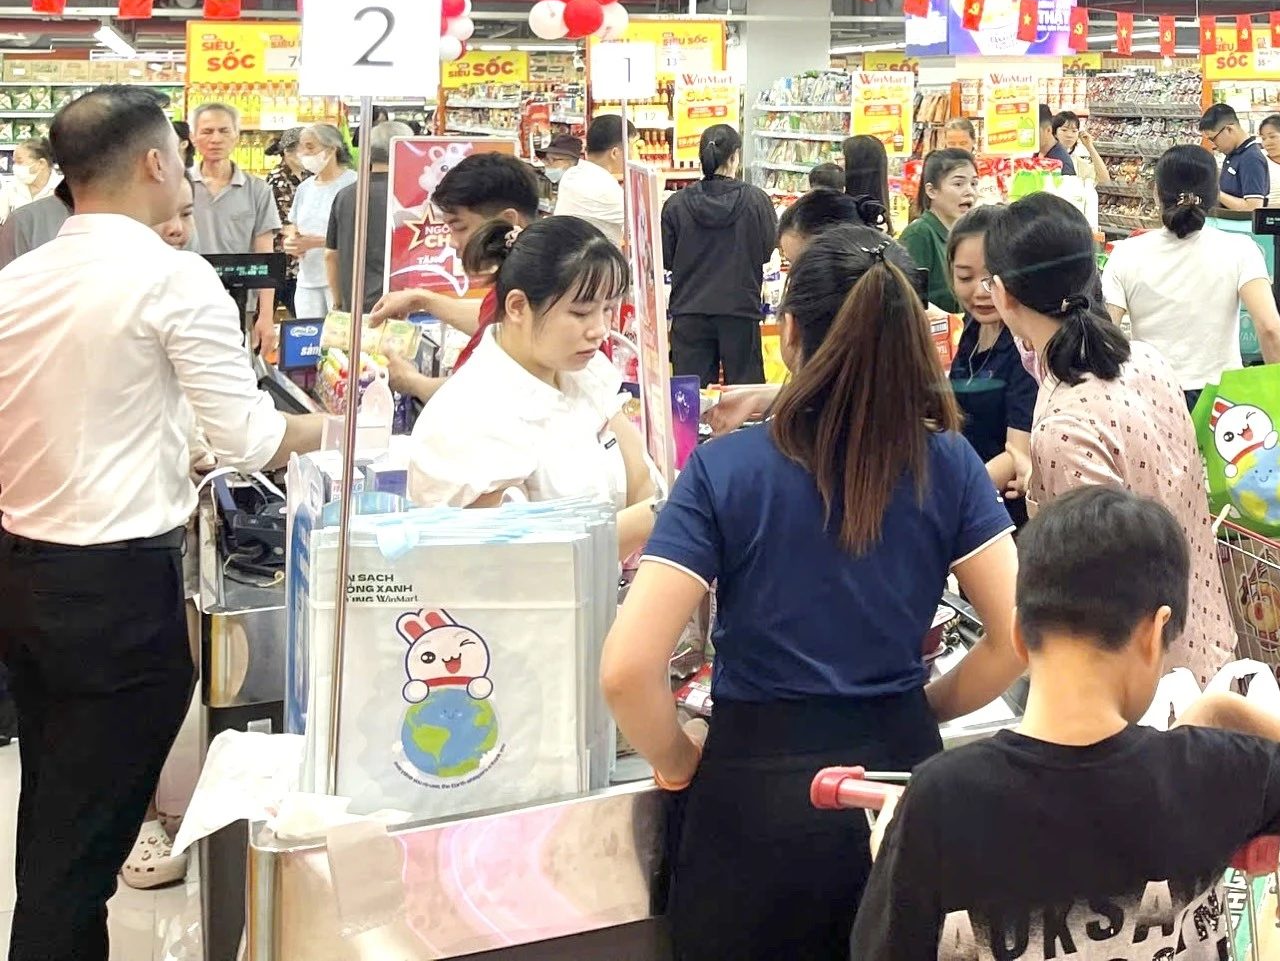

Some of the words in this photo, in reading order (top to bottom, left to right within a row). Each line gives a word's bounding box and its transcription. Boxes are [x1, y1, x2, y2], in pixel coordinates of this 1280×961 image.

[353, 6, 395, 67] 2
[201, 39, 235, 51] SIÊU
[207, 48, 255, 72] SỐC
[473, 56, 513, 76] SỐC
[623, 57, 631, 83] 1
[682, 73, 733, 86] WinMart
[859, 73, 907, 85] WinMart
[990, 73, 1032, 85] WinMart
[346, 582, 374, 593] ỐNG
[376, 585, 413, 593] XANH
[376, 594, 418, 603] WinMart
